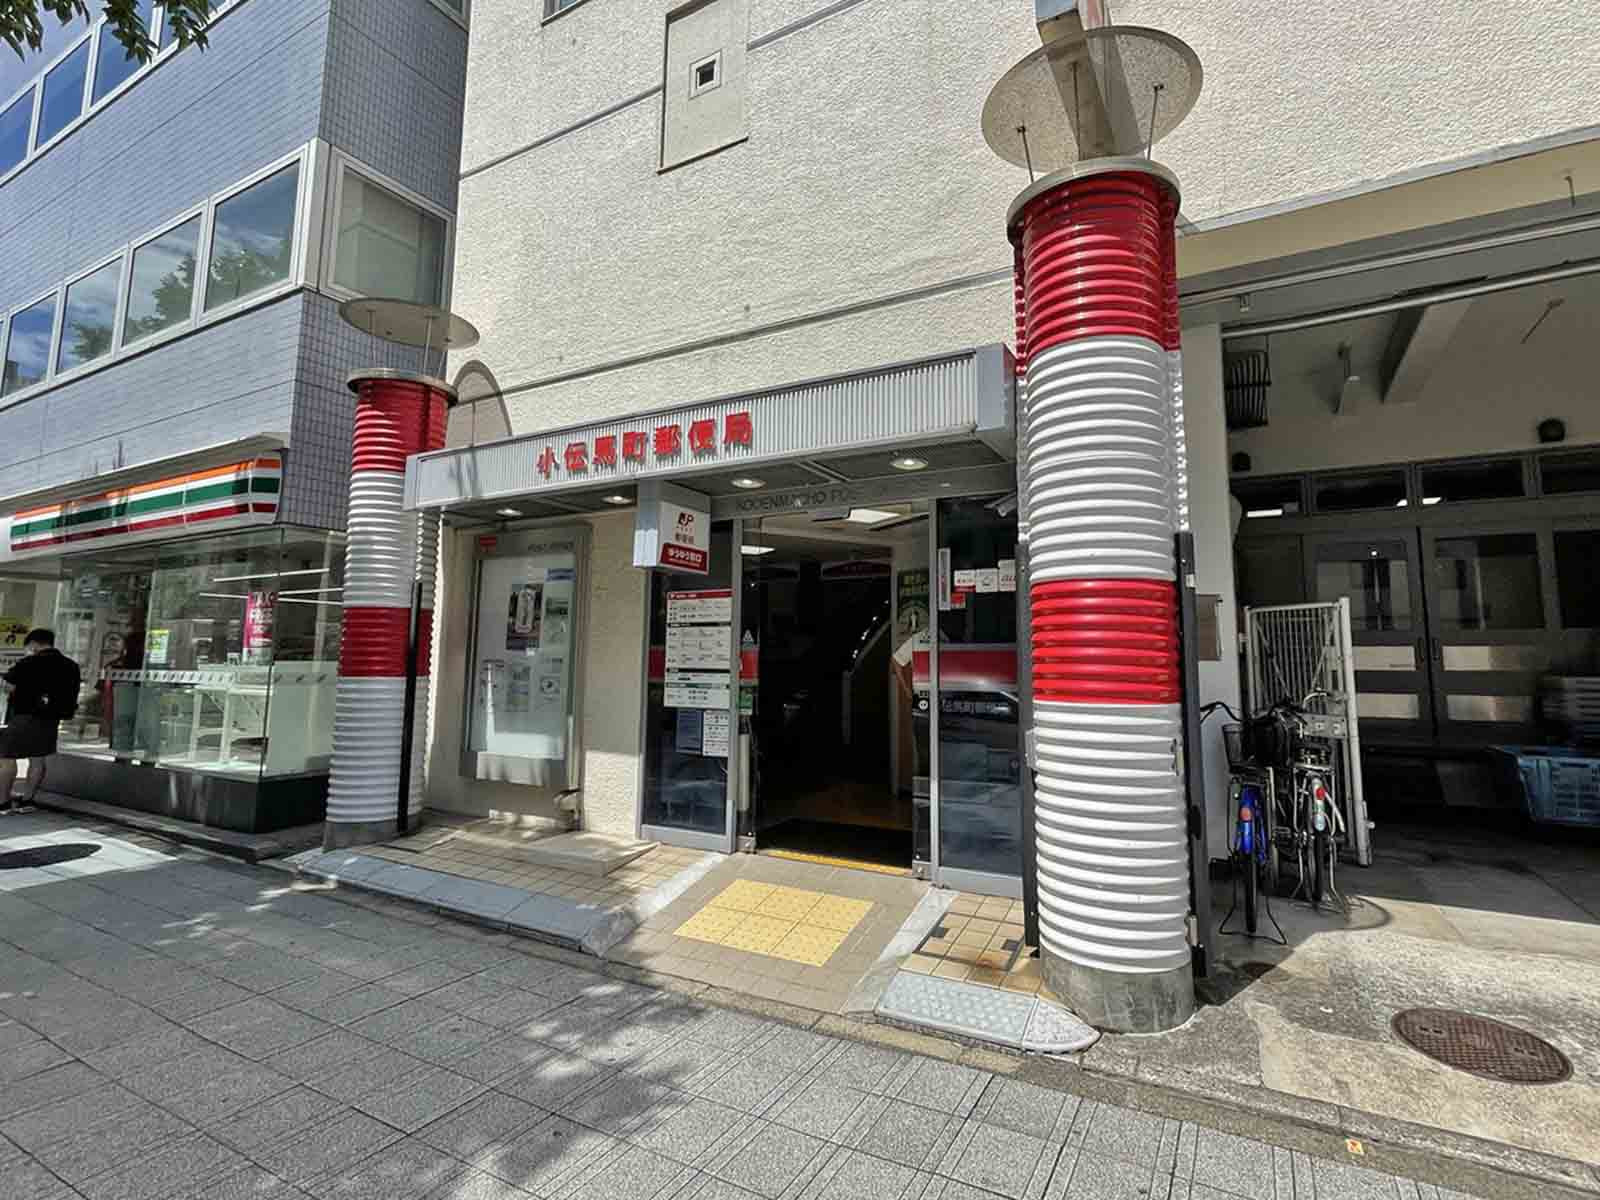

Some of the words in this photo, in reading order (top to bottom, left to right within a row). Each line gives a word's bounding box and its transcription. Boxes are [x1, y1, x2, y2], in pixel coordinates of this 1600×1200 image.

[537, 411, 752, 480] 小伝馬町郵便局
